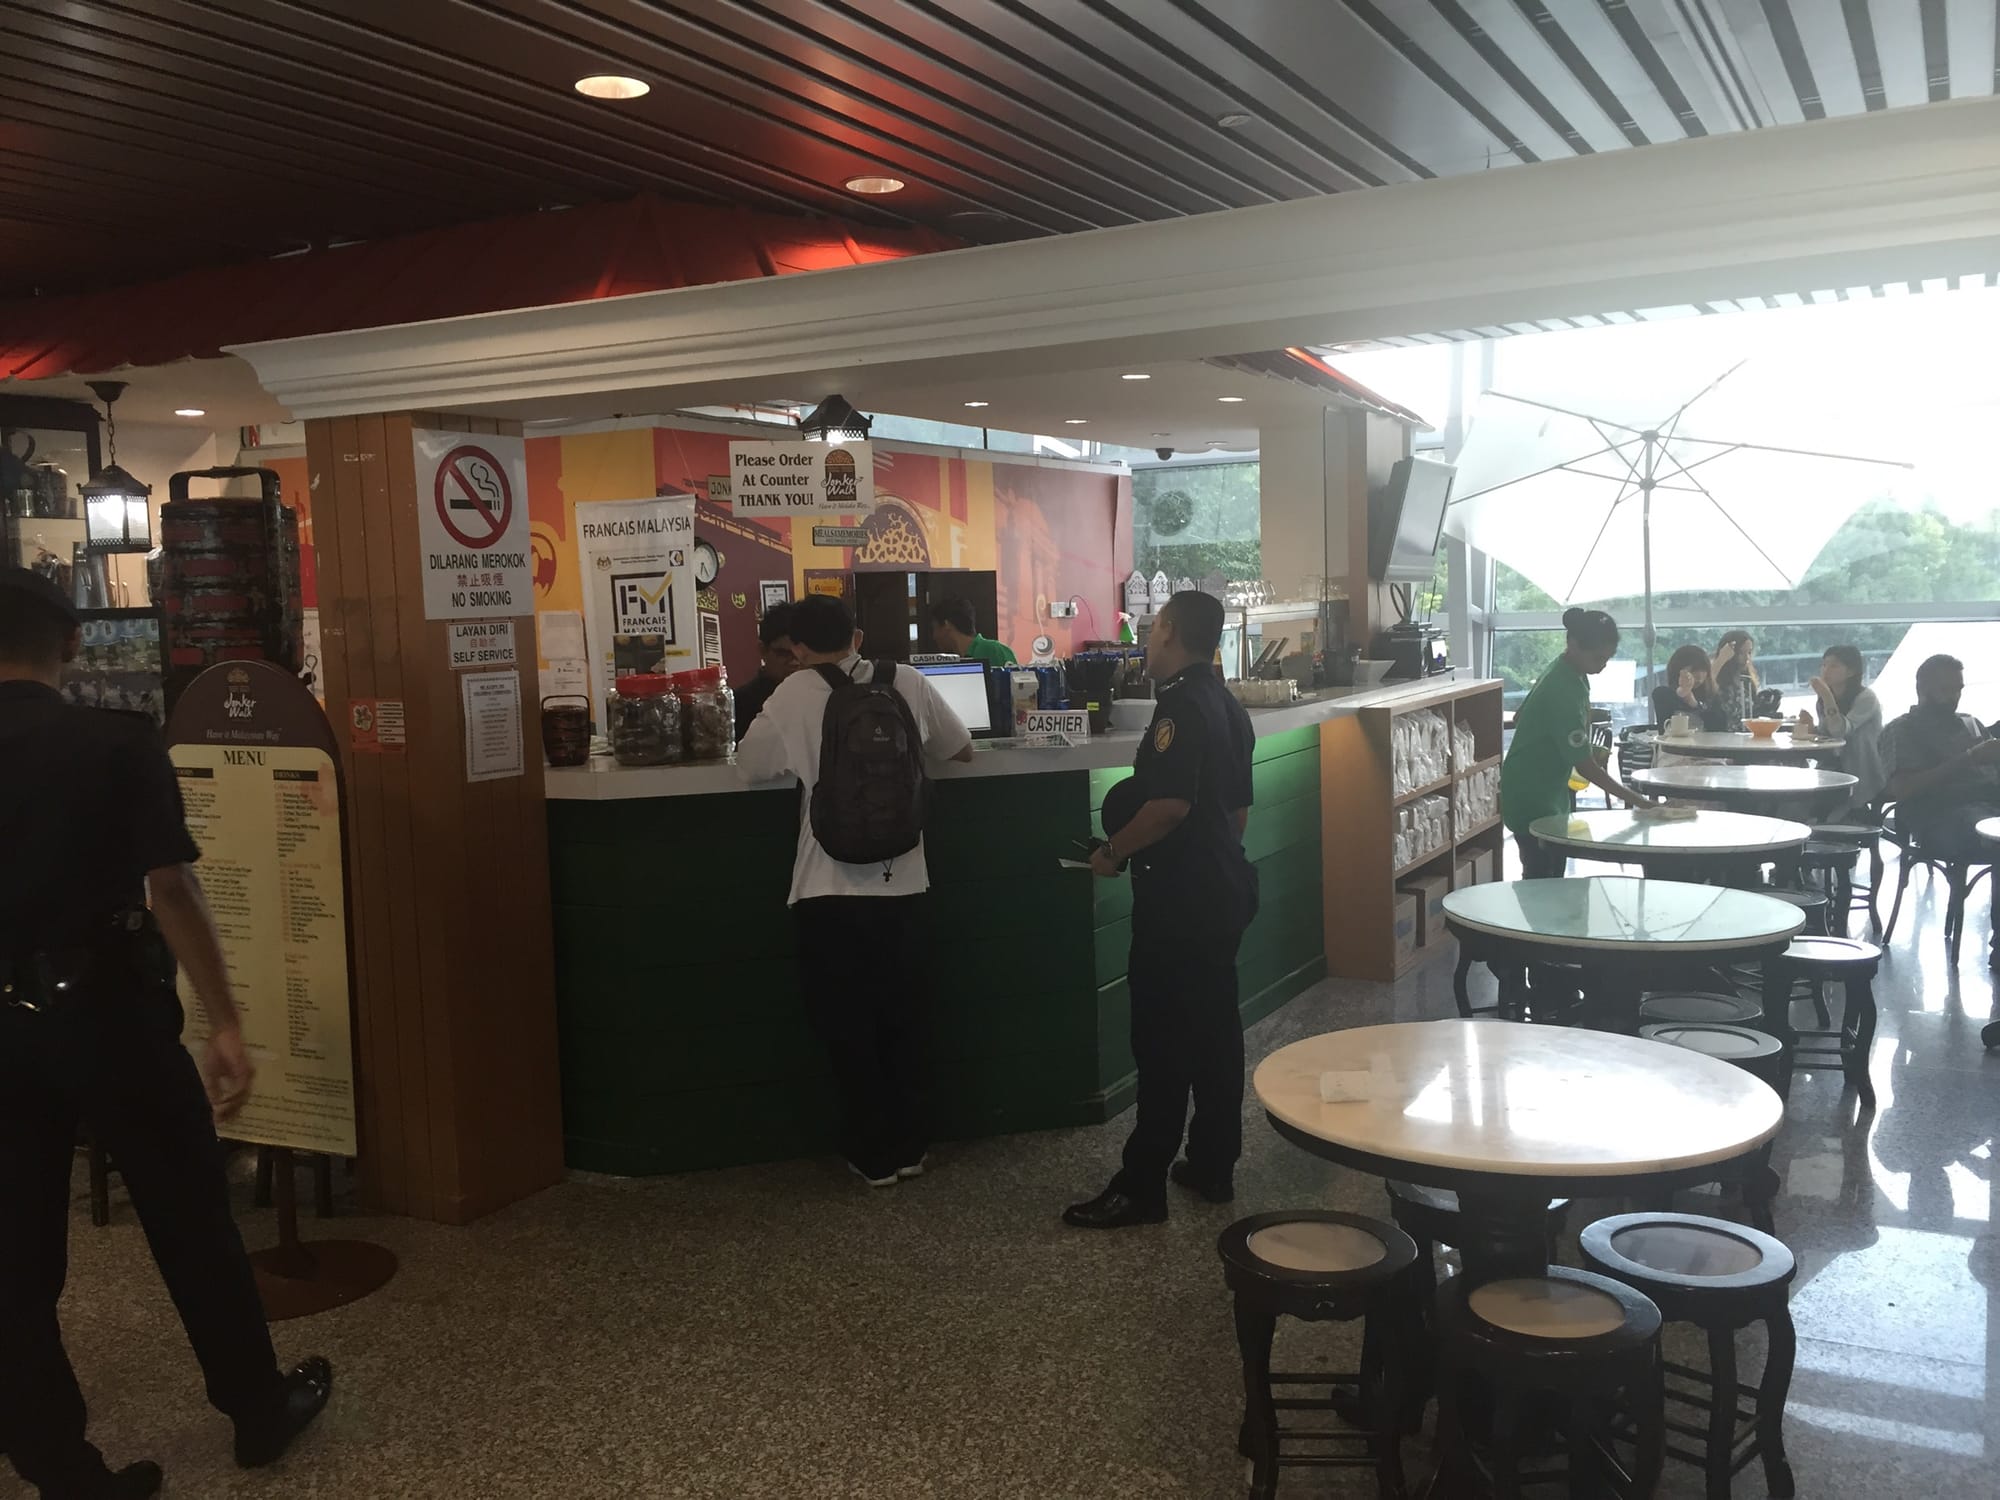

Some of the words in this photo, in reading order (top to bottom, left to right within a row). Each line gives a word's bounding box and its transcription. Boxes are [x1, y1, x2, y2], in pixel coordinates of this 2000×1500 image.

[735, 454, 775, 466] Please
[779, 454, 814, 466] Order
[742, 475, 756, 486] At
[760, 474, 809, 486] Counter
[821, 472, 860, 489] Jonker
[827, 485, 855, 496] Walk
[739, 494, 781, 507] THANK
[785, 494, 814, 506] YOU!
[583, 521, 635, 538] FRANCAIS
[637, 516, 691, 534] MALAYSIA
[430, 554, 478, 569] DILARANG
[482, 553, 526, 568] MEROKOK
[452, 592, 466, 607] NO
[470, 591, 511, 606] SMOKING
[623, 616, 667, 626] FRANCAIS
[456, 626, 486, 637] LAYAN
[489, 624, 508, 636] DIRI
[453, 651, 475, 663] SELF
[478, 649, 514, 661] SERVICE
[224, 692, 256, 708] Jonker
[229, 707, 252, 717] Walk
[1028, 716, 1082, 732] CASHIER
[224, 750, 266, 766] MENU
